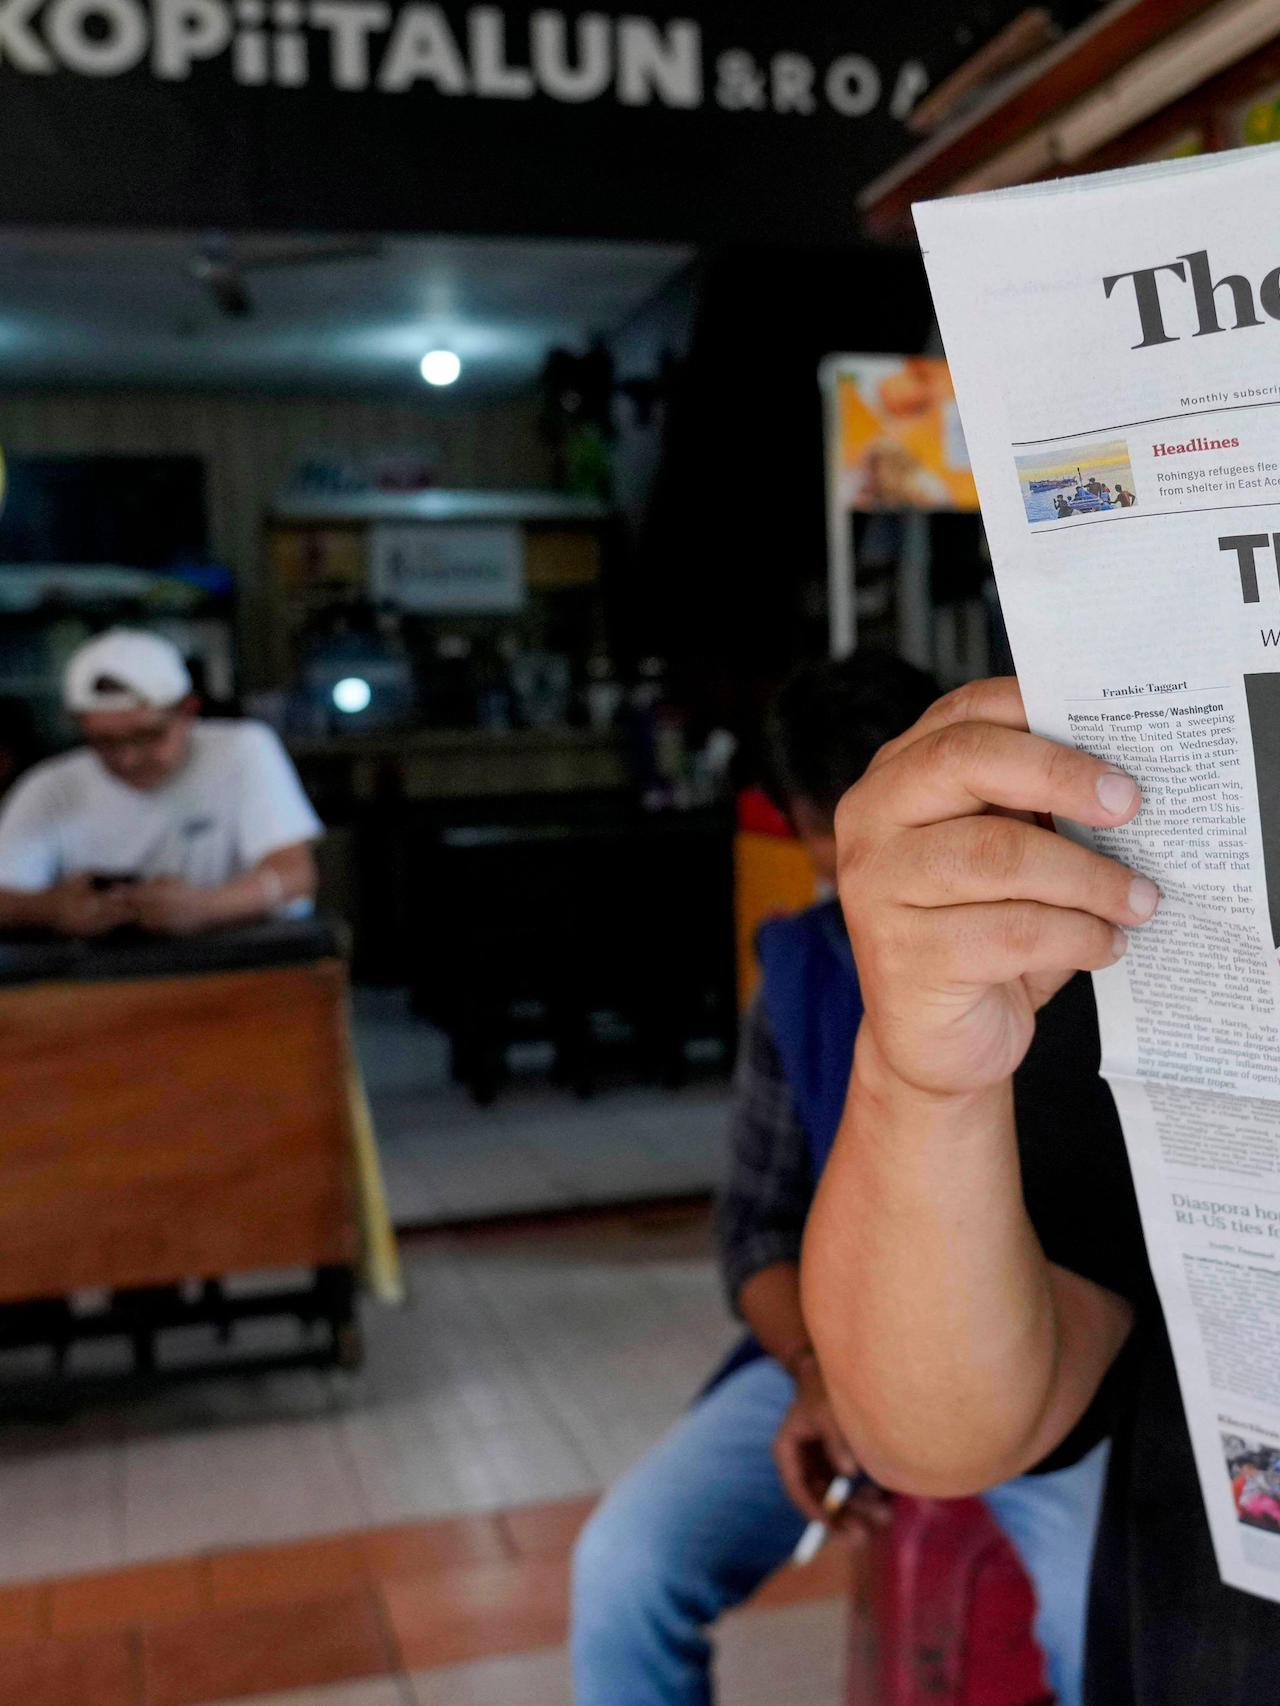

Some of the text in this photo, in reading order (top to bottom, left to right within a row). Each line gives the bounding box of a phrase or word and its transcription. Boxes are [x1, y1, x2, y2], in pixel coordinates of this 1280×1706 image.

[1180, 391, 1228, 407] Monthly
[1151, 436, 1240, 458] Headlines
[1156, 461, 1278, 484] Rohingya refugees flee
[1158, 486, 1184, 496] from
[1186, 482, 1222, 493] shelter
[1224, 480, 1235, 490] in
[1237, 477, 1261, 488] East
[1102, 680, 1186, 697] Frankie Taggart
[1067, 703, 1224, 722] Agence France-Presse/Washington
[1171, 1193, 1250, 1218] Diaspora
[1232, 1218, 1263, 1235] ties
